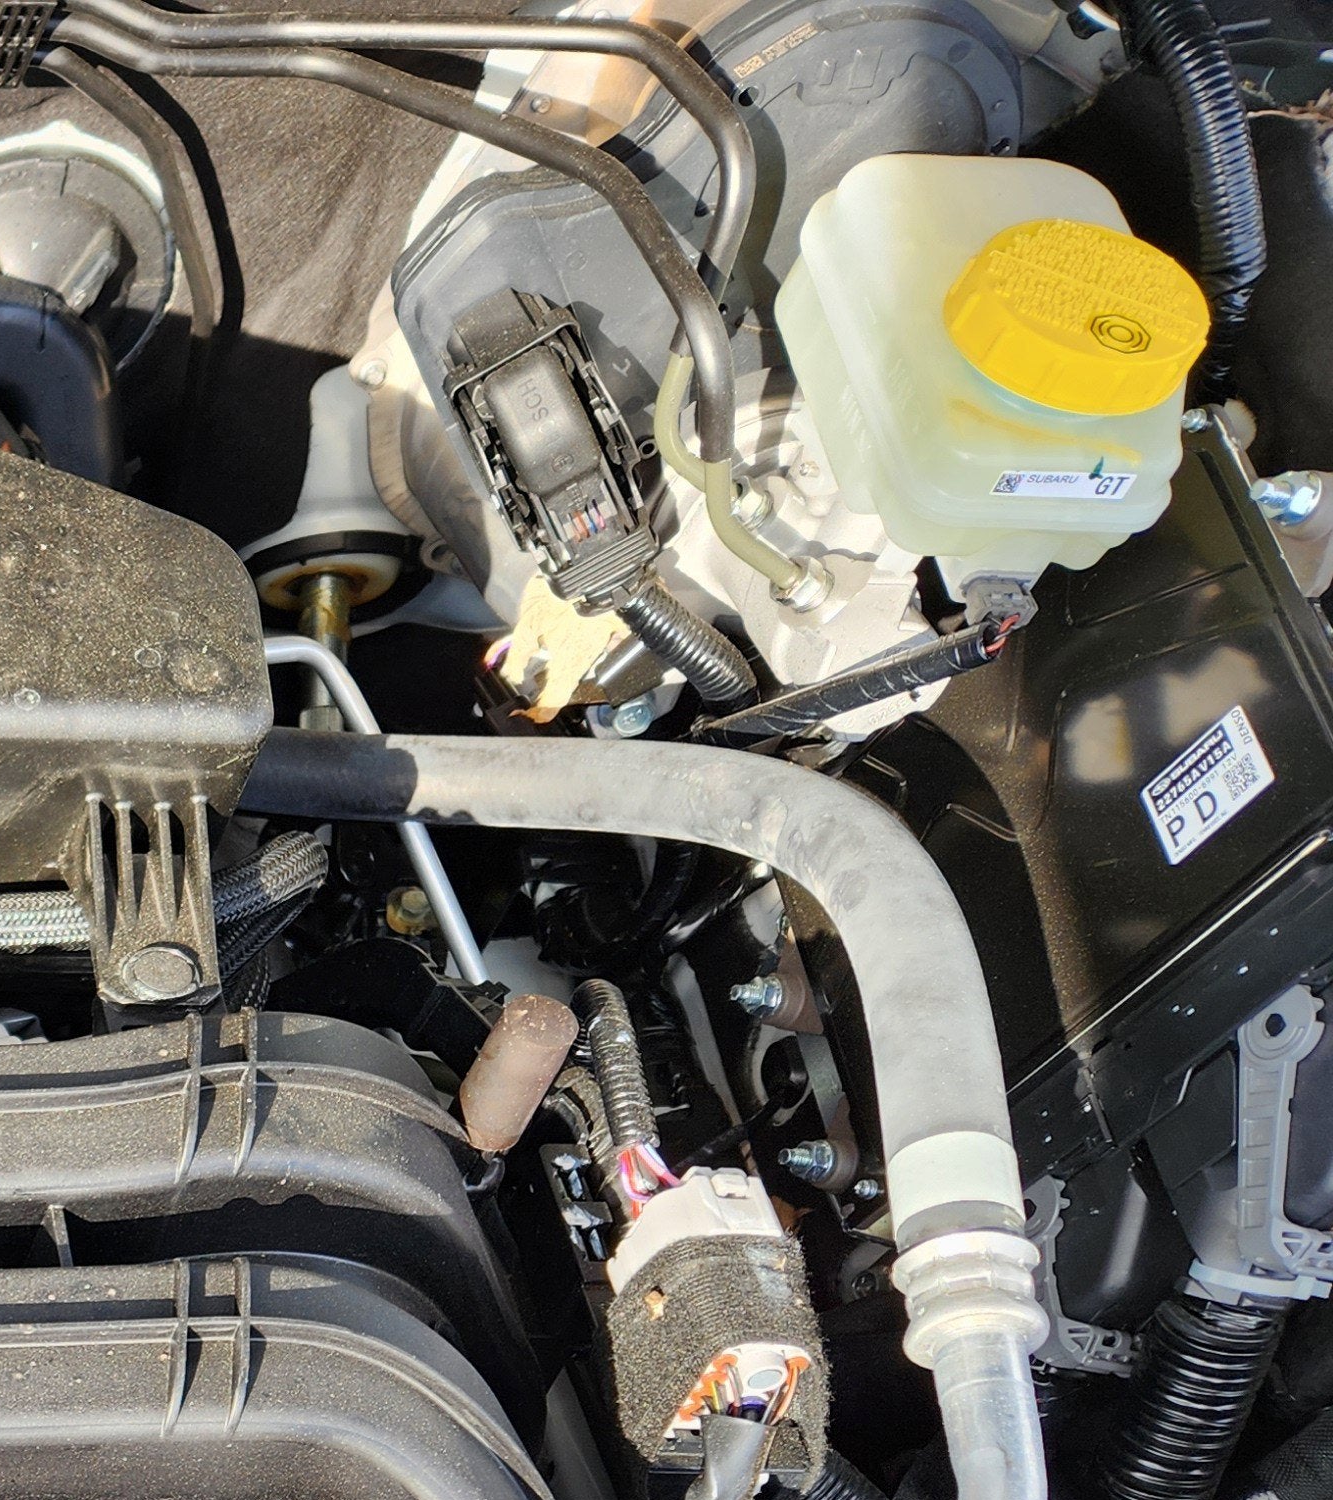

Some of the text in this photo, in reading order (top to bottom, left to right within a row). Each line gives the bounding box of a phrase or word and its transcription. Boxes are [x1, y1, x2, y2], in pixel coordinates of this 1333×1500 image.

[1026, 474, 1079, 484] SUBARU
[1094, 476, 1130, 496] GT
[1231, 709, 1253, 745] DENSO
[1155, 740, 1233, 812] 22765AV15A
[1169, 728, 1224, 781] SUBARU
[1165, 814, 1186, 849] P
[1193, 790, 1218, 824] D
